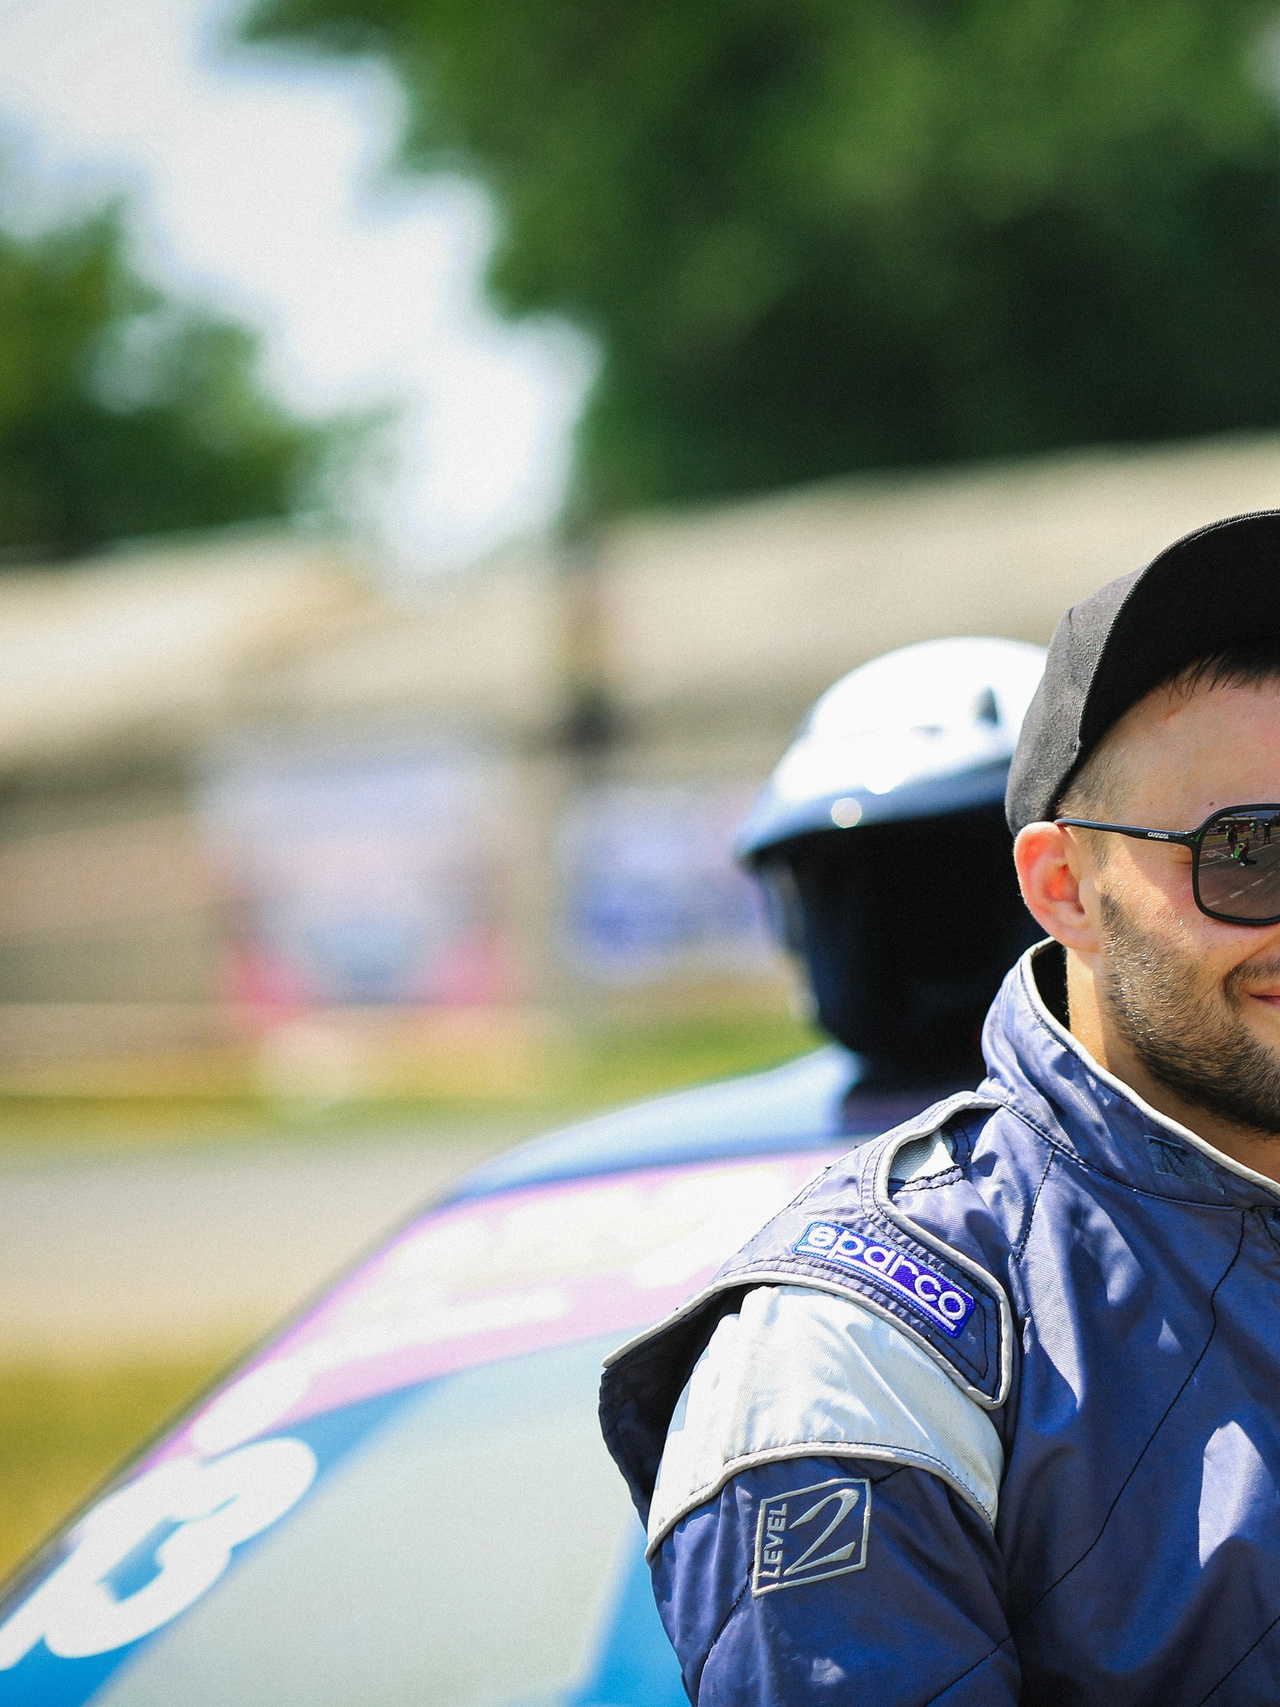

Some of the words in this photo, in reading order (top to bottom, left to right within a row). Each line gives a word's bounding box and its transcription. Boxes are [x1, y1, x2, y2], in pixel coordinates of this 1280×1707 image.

[806, 1226, 967, 1321] sparco
[759, 1502, 788, 1579] LEVEL
[782, 1488, 860, 1577] 2
